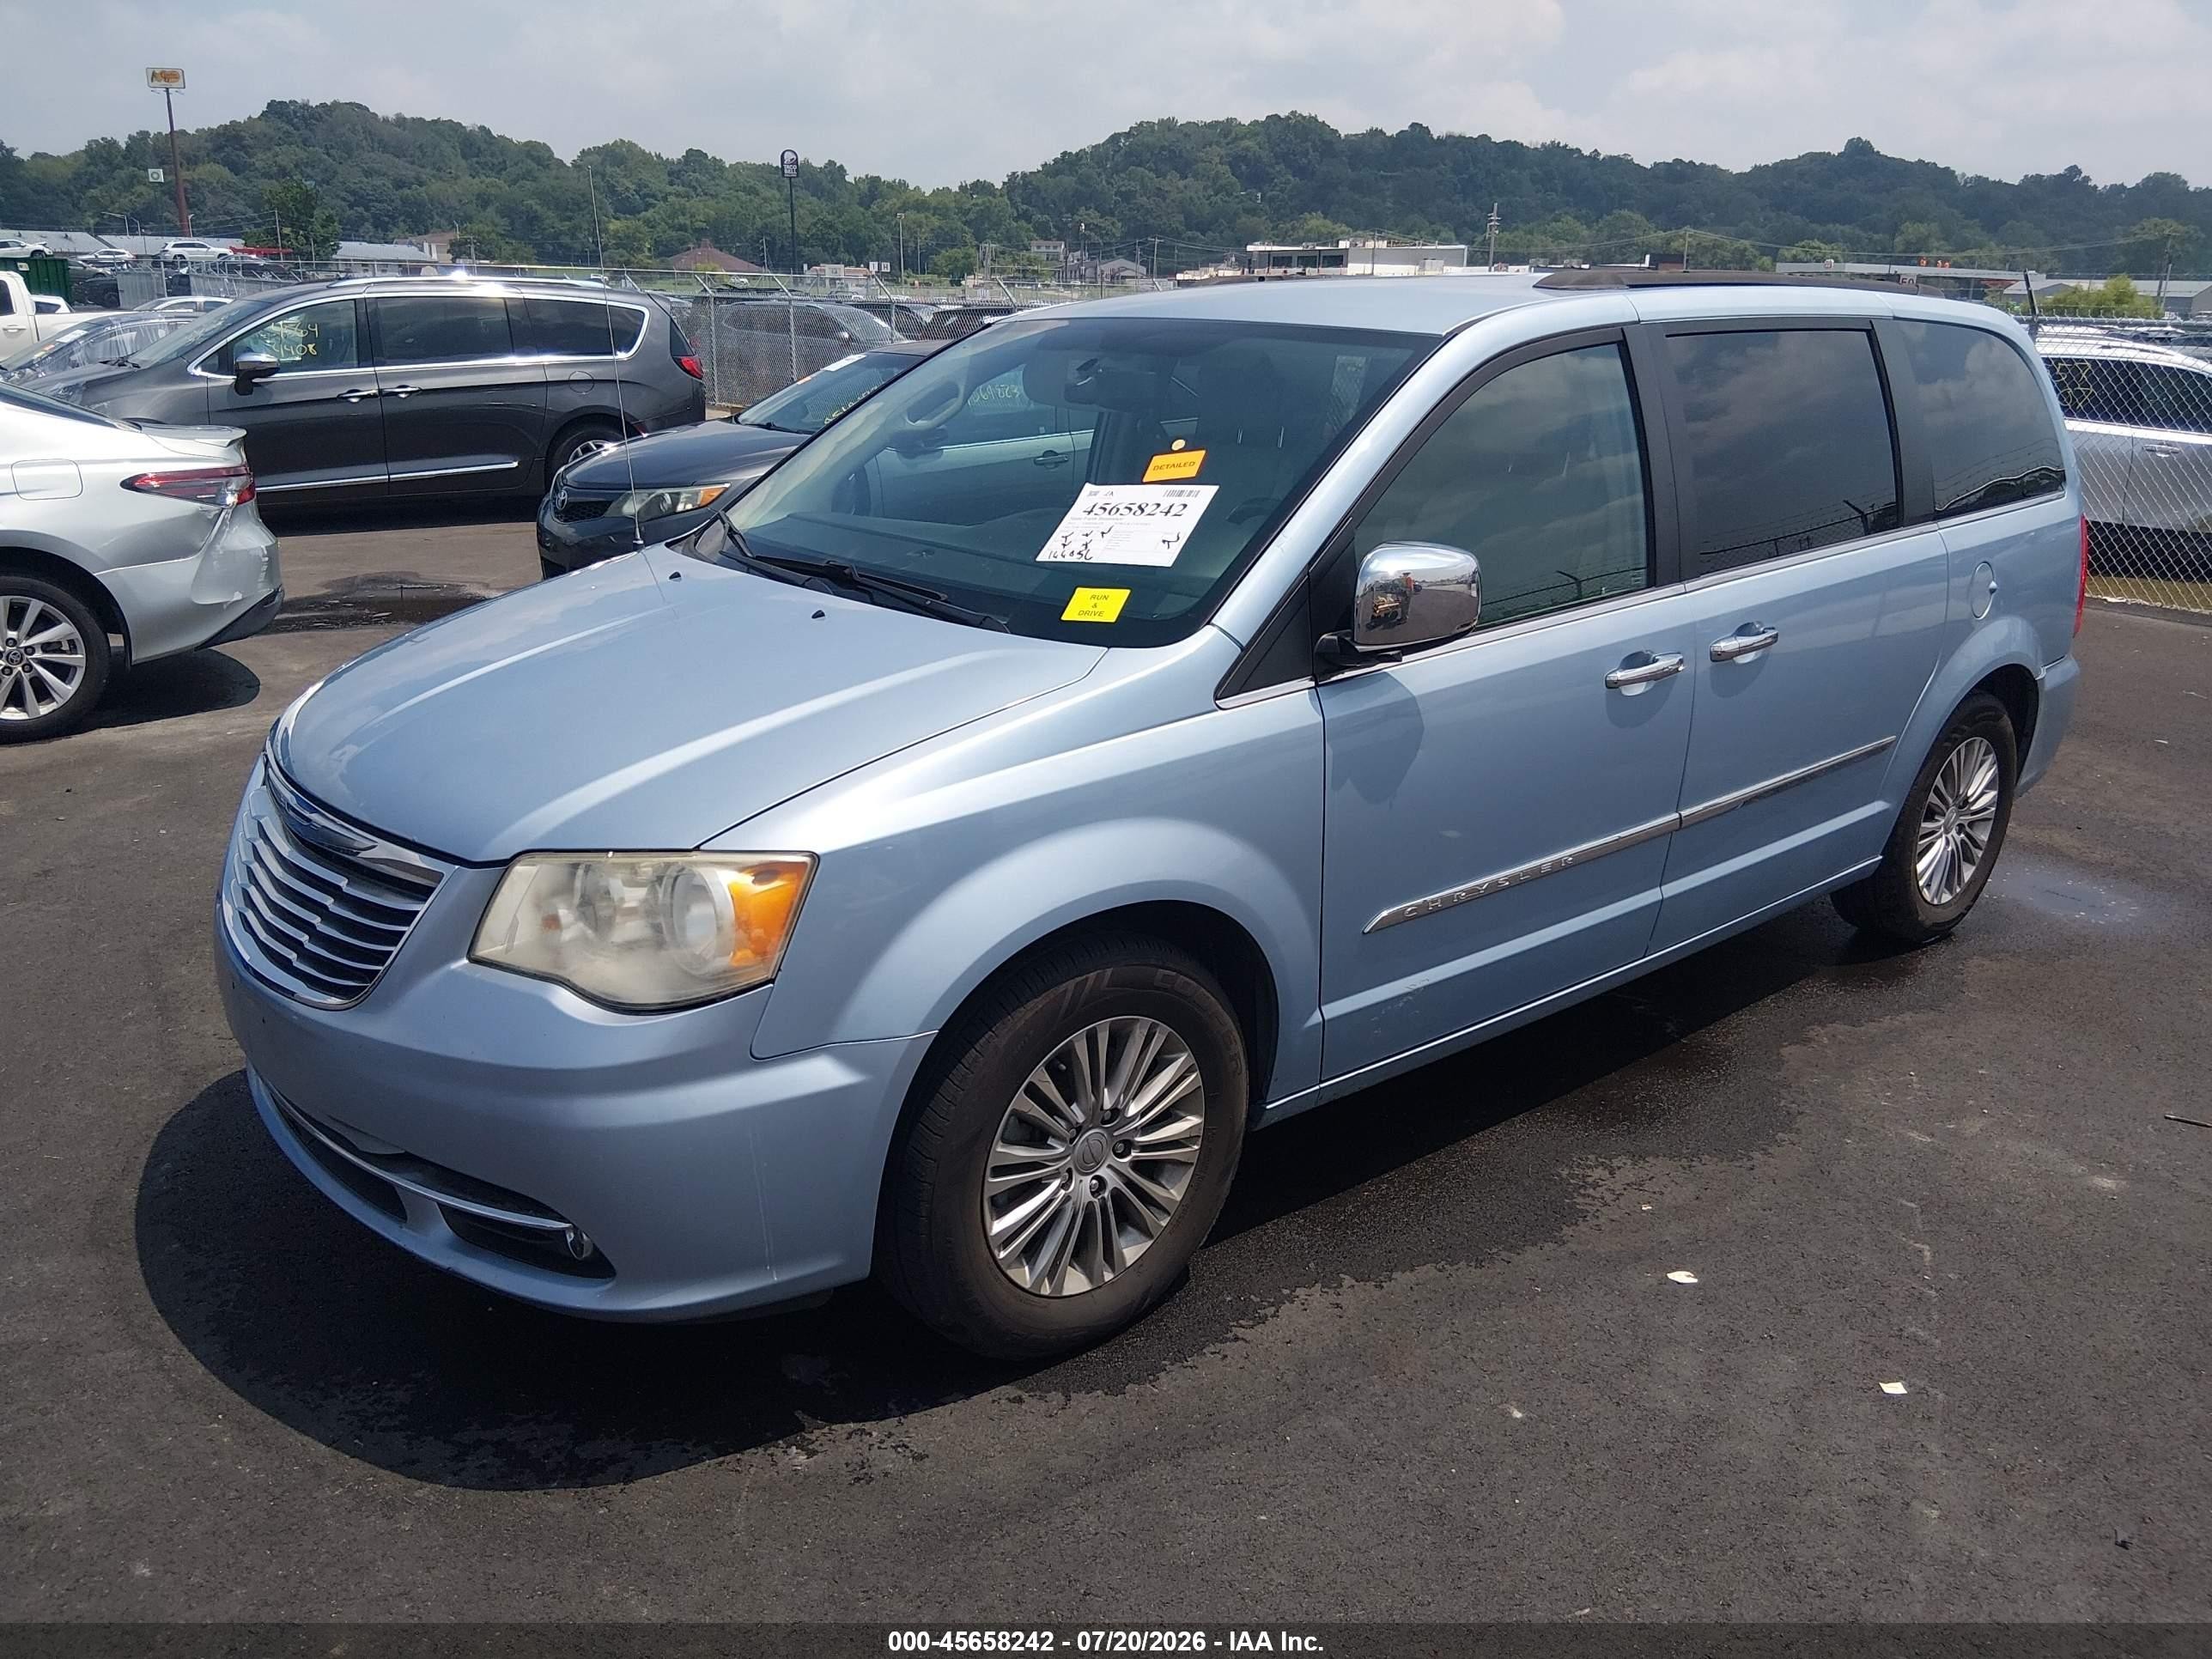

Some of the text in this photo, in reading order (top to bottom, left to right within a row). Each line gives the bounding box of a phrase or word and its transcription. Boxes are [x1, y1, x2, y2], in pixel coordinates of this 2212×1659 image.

[1152, 461, 1196, 471] DETAILED
[1082, 502, 1188, 517] 45658242
[1403, 855, 1574, 918] CHRYSLER
